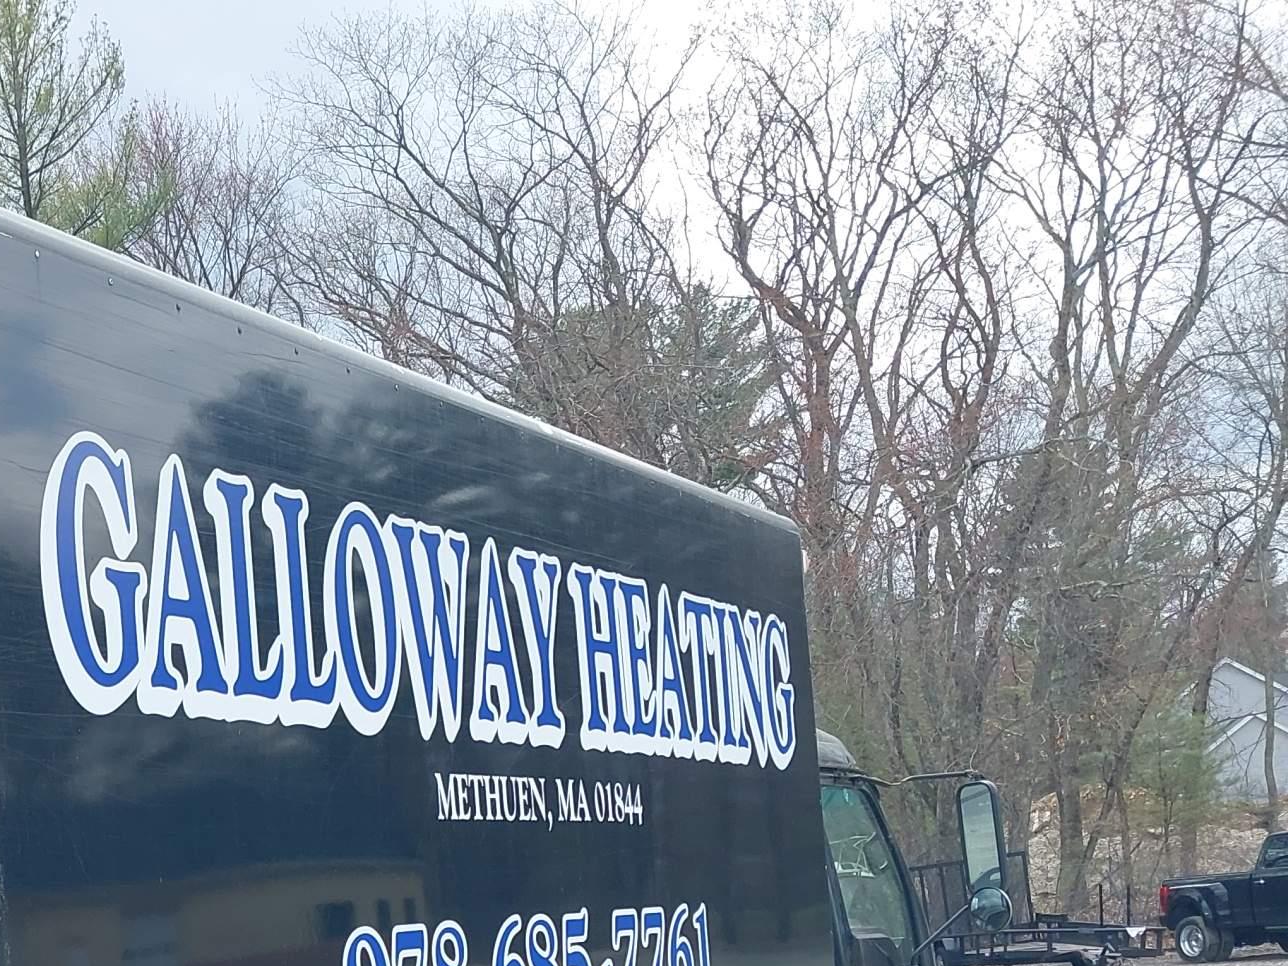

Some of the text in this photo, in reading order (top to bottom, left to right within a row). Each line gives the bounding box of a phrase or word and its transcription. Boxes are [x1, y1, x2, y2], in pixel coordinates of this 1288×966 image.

[39, 430, 796, 770] GALLOWAY HEATING
[434, 772, 643, 832] METHUEN, MA 01844
